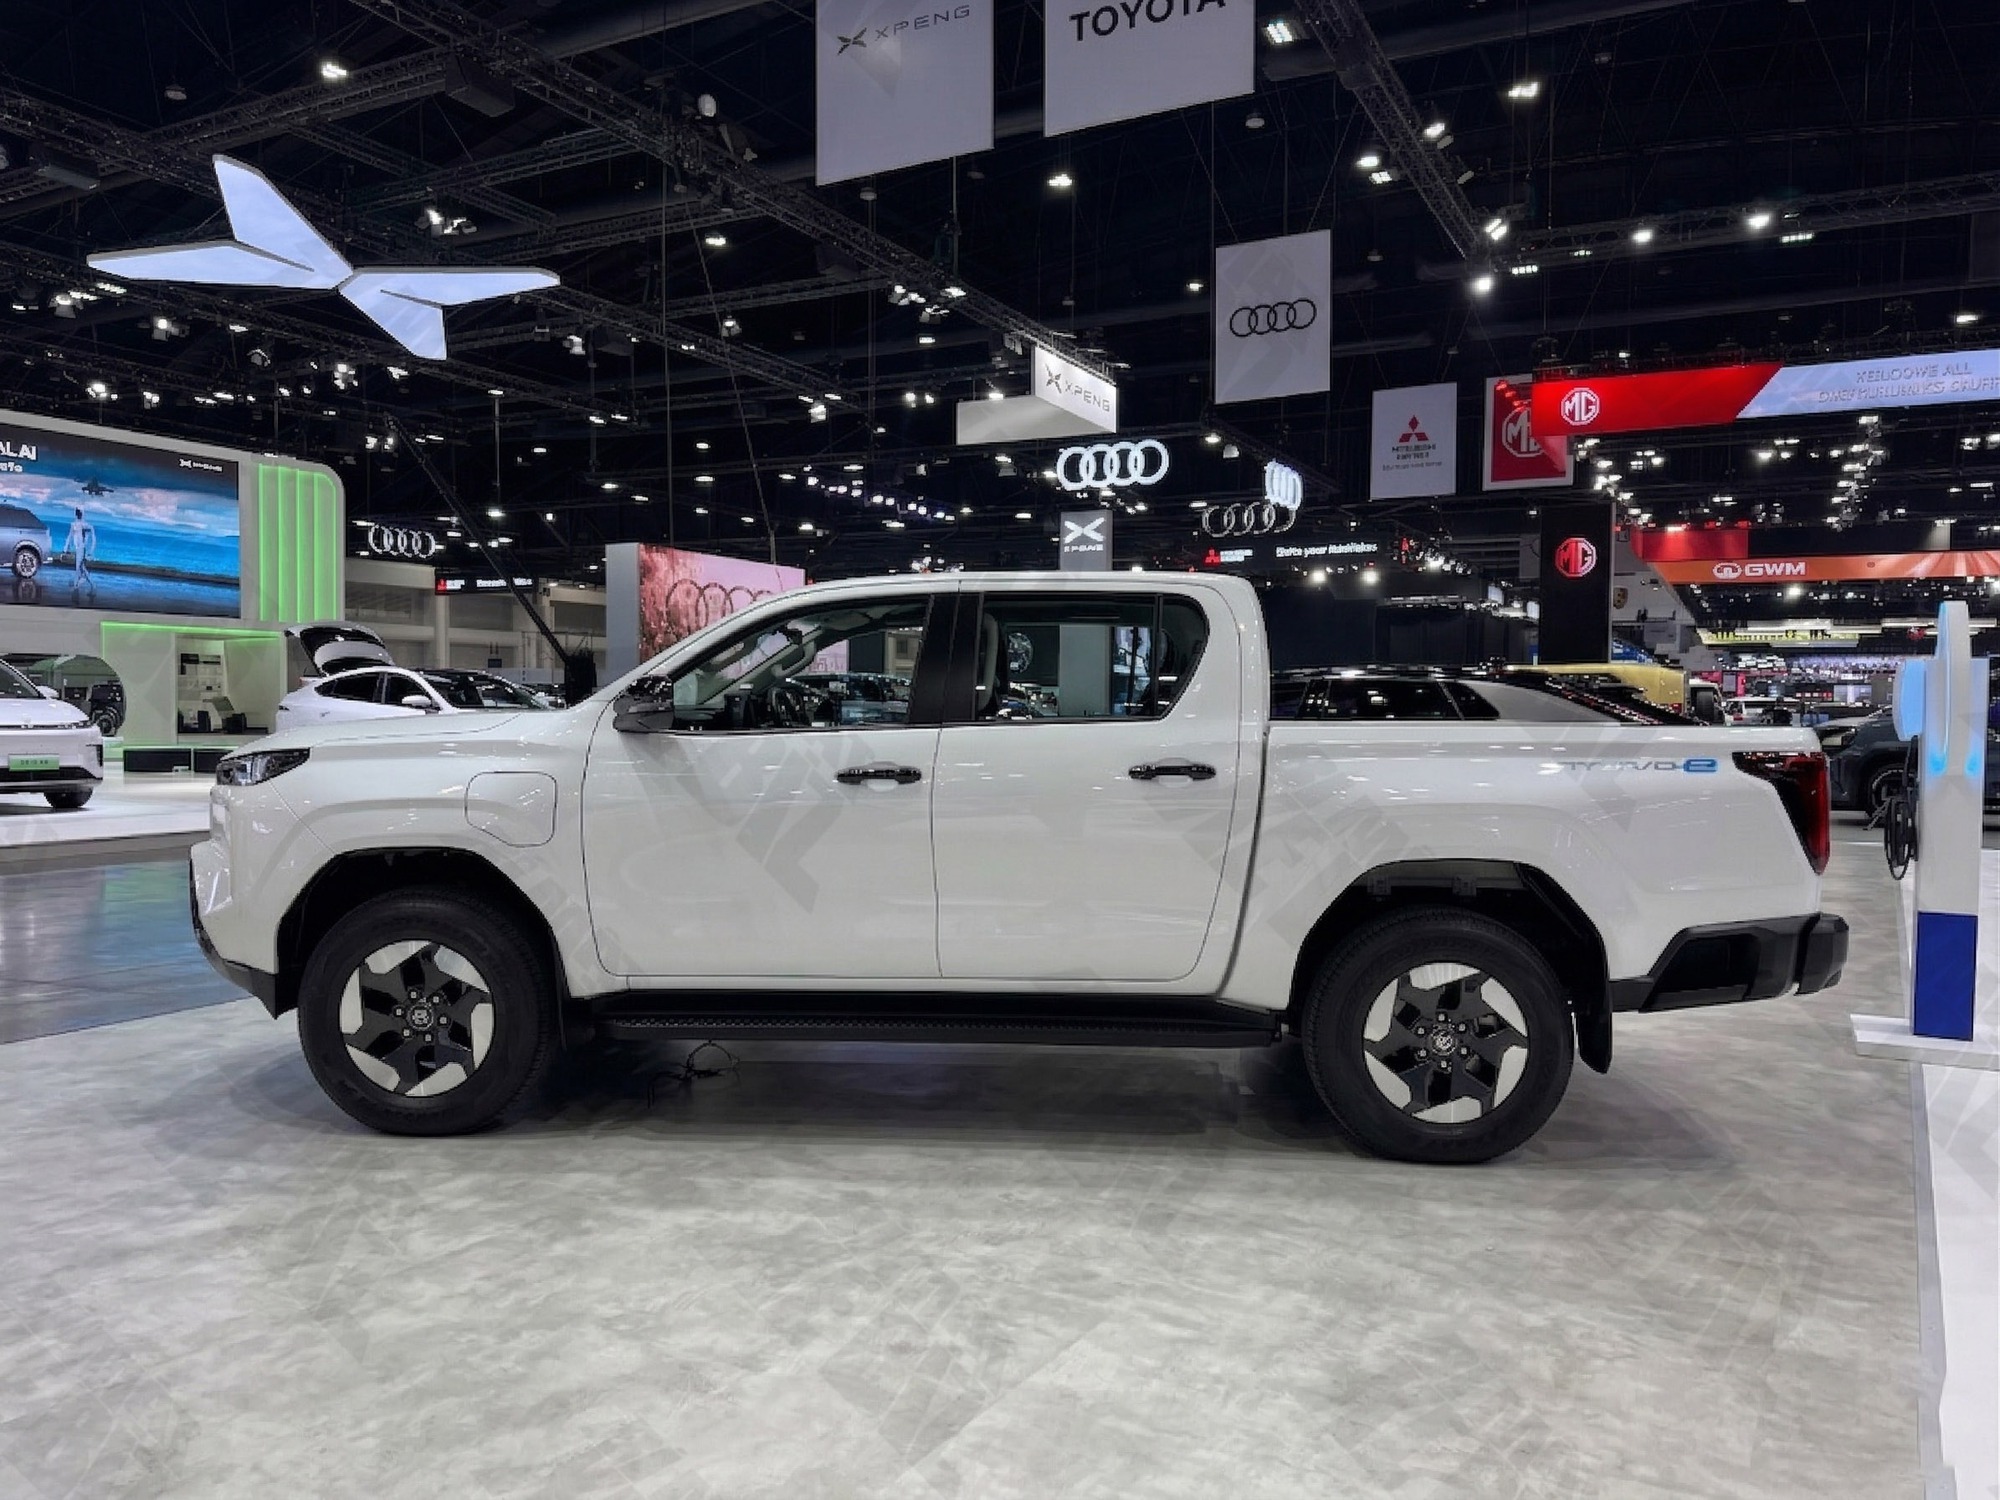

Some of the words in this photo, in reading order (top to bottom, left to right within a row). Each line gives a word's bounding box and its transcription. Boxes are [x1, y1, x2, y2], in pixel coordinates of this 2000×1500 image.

[874, 5, 970, 41] XPENG
[1563, 390, 1598, 423] MG
[1506, 406, 1541, 453] M
[1558, 540, 1595, 575] MG
[1744, 562, 1806, 577] GWM
